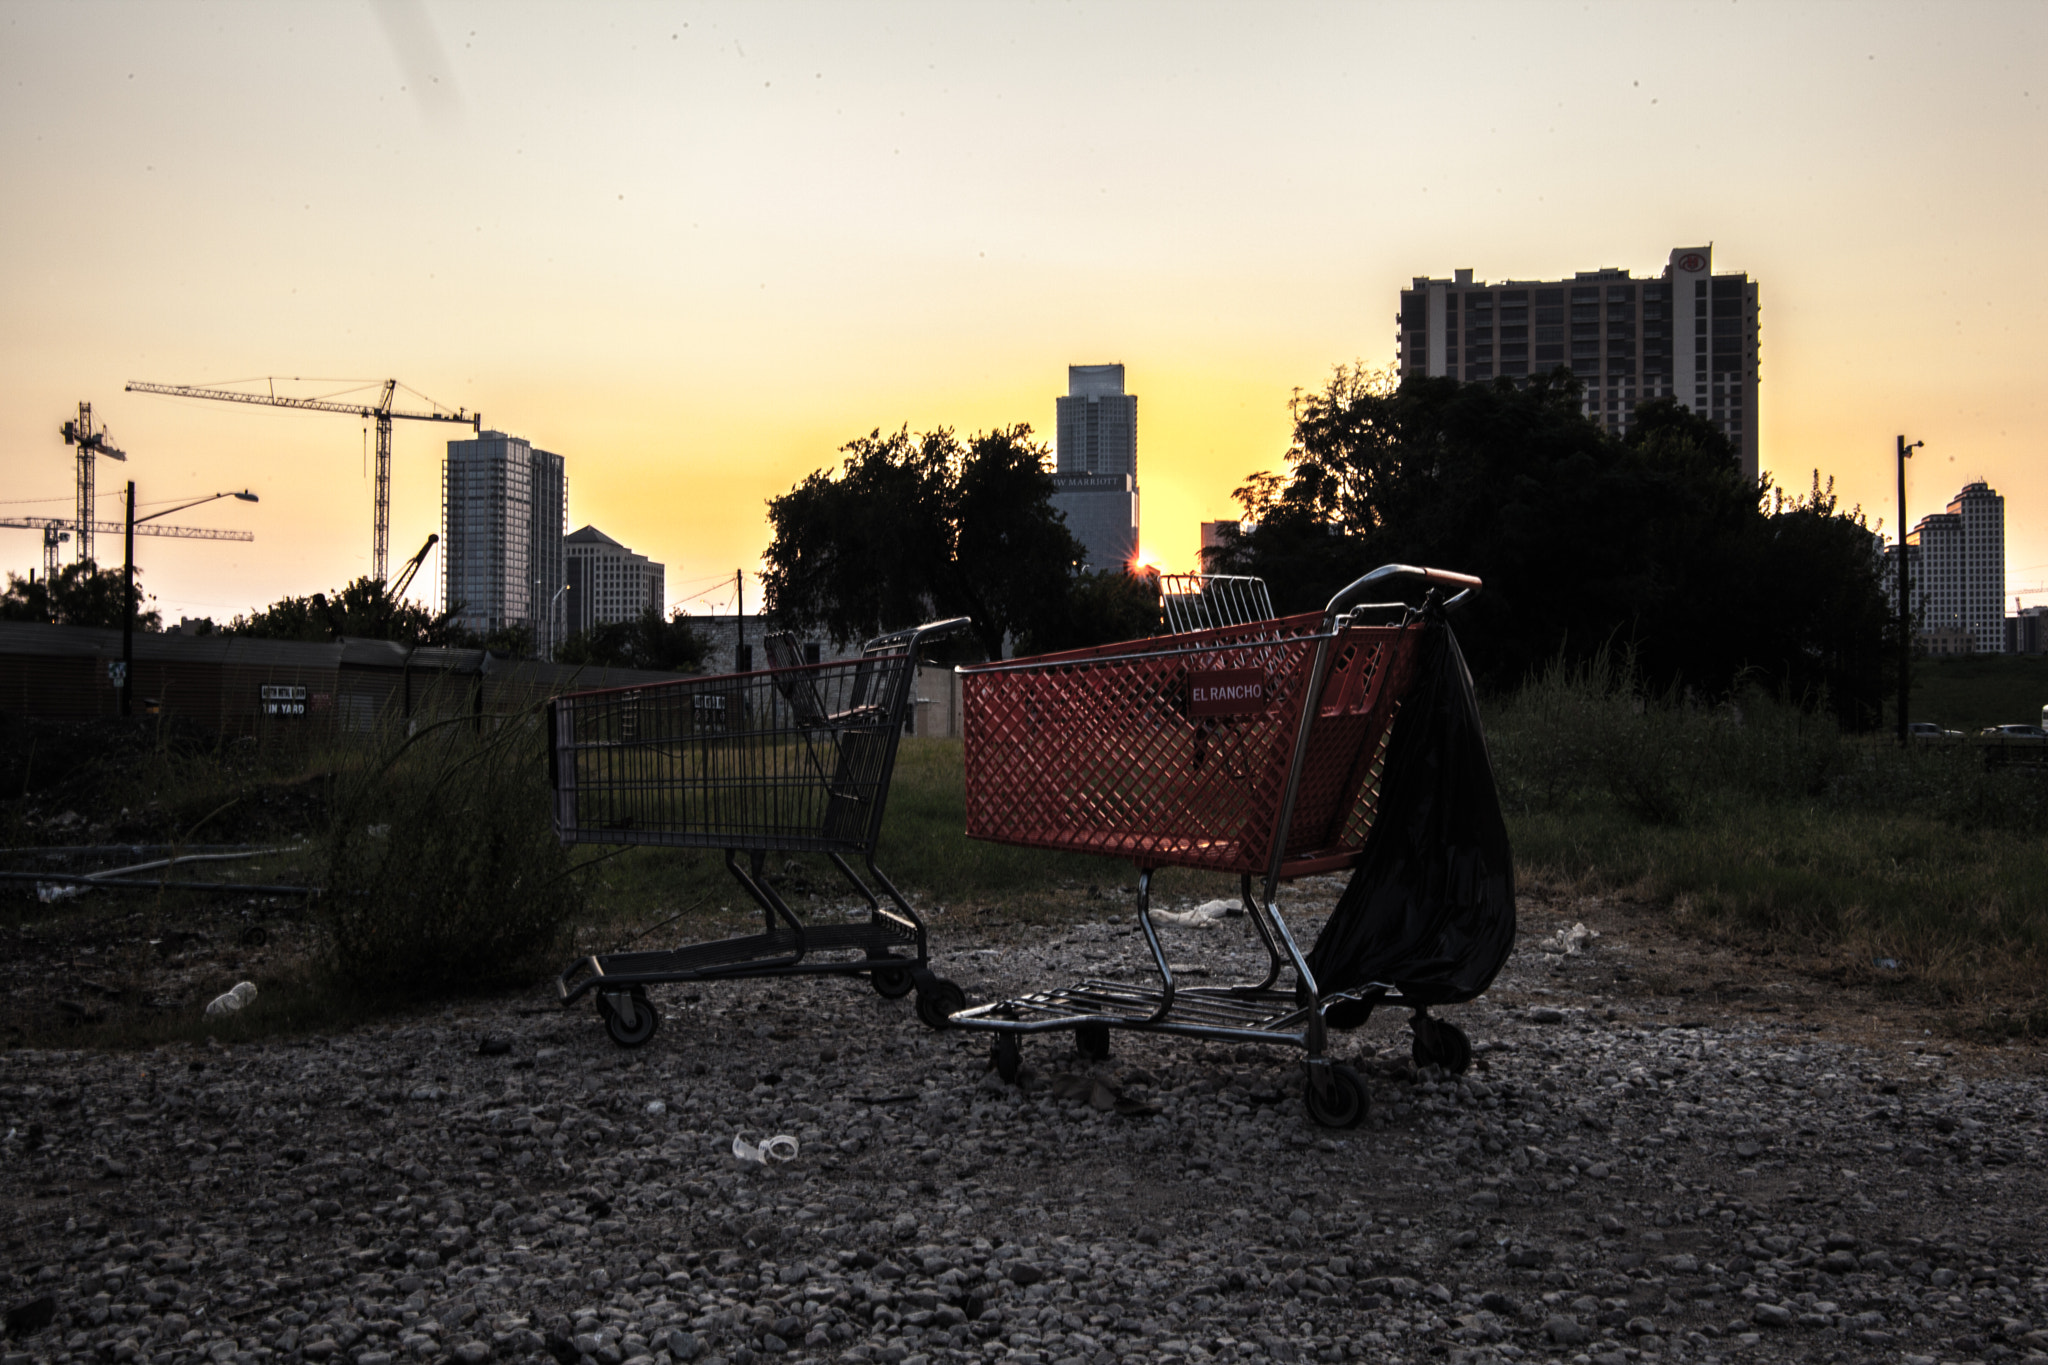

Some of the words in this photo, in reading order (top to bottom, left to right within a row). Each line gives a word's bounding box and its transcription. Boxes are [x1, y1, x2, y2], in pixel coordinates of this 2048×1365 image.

[1068, 477, 1118, 487] MARRIOTT
[1192, 687, 1208, 702] EL
[1210, 683, 1262, 701] RANCHO
[281, 703, 305, 715] YARD
